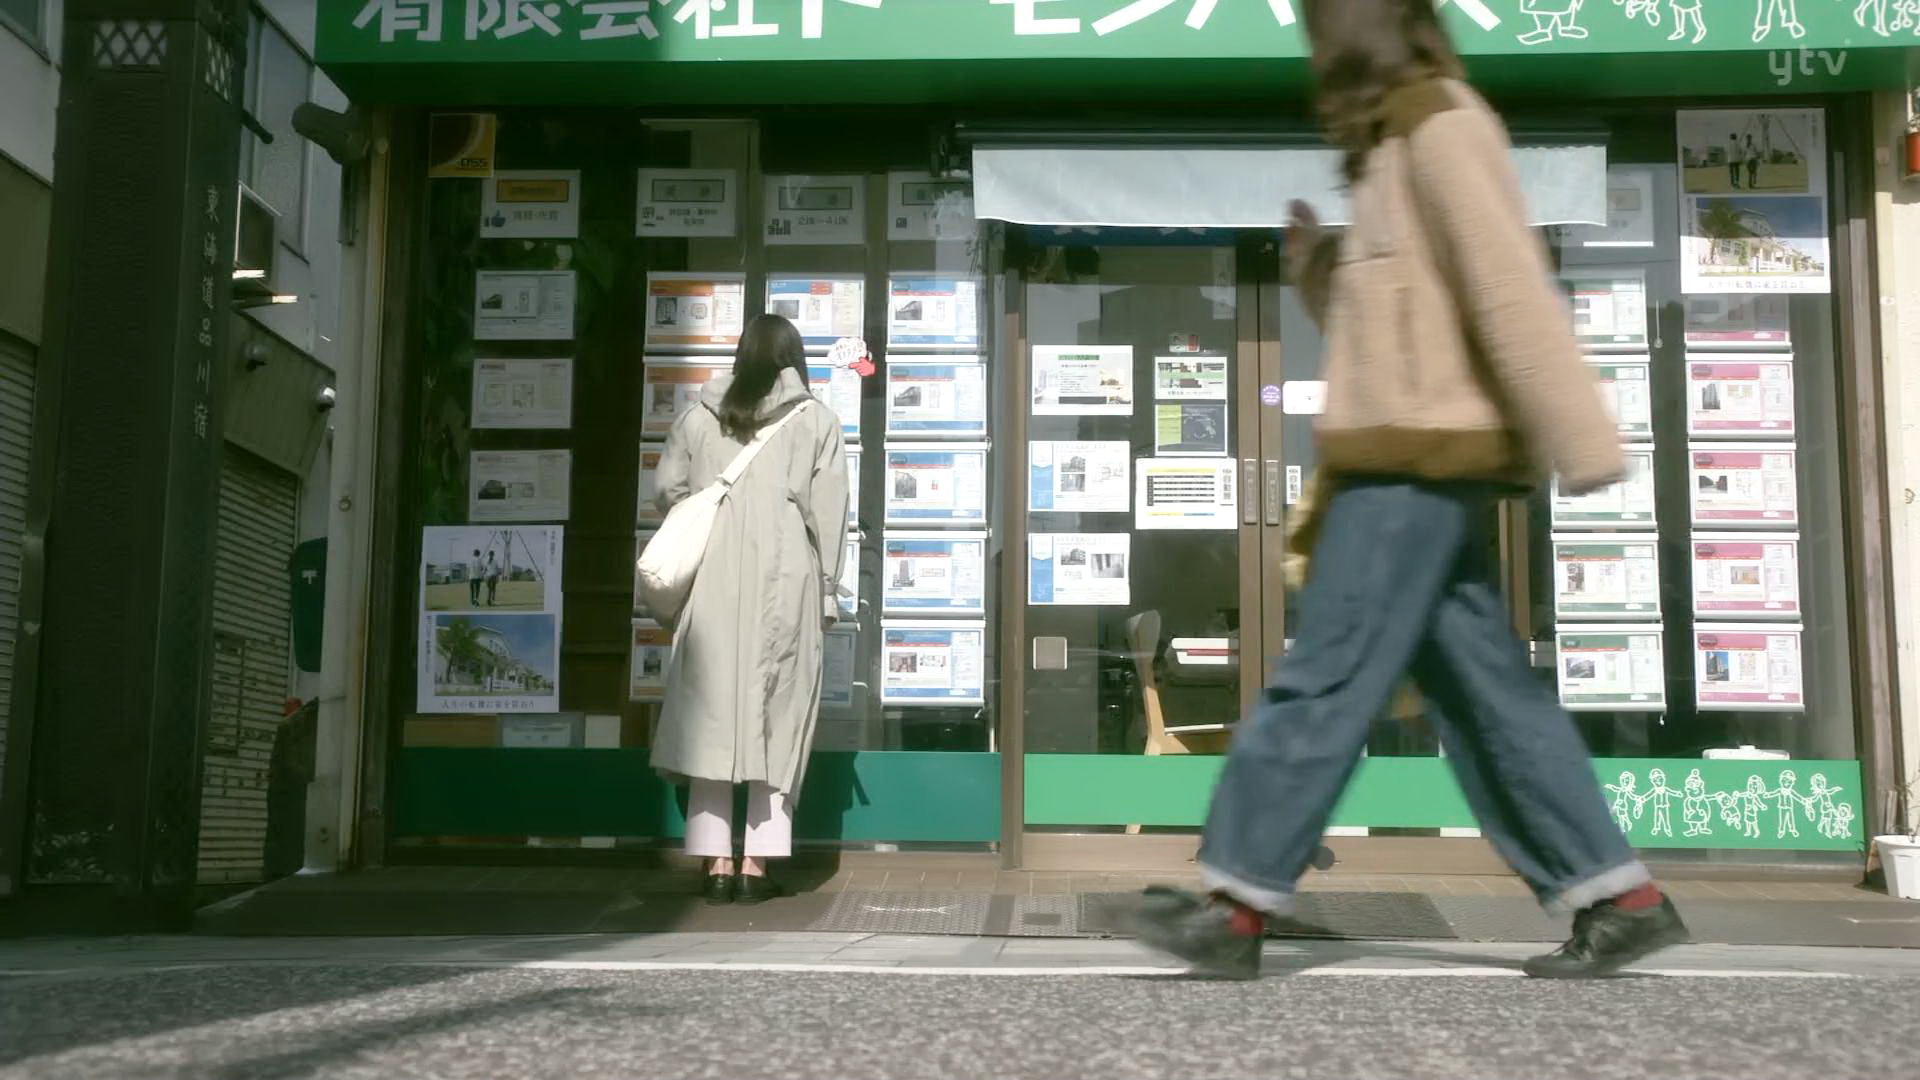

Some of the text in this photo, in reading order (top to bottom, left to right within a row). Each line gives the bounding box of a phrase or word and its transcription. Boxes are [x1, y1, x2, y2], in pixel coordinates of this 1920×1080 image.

[193, 184, 219, 440] 東海道品川宿
